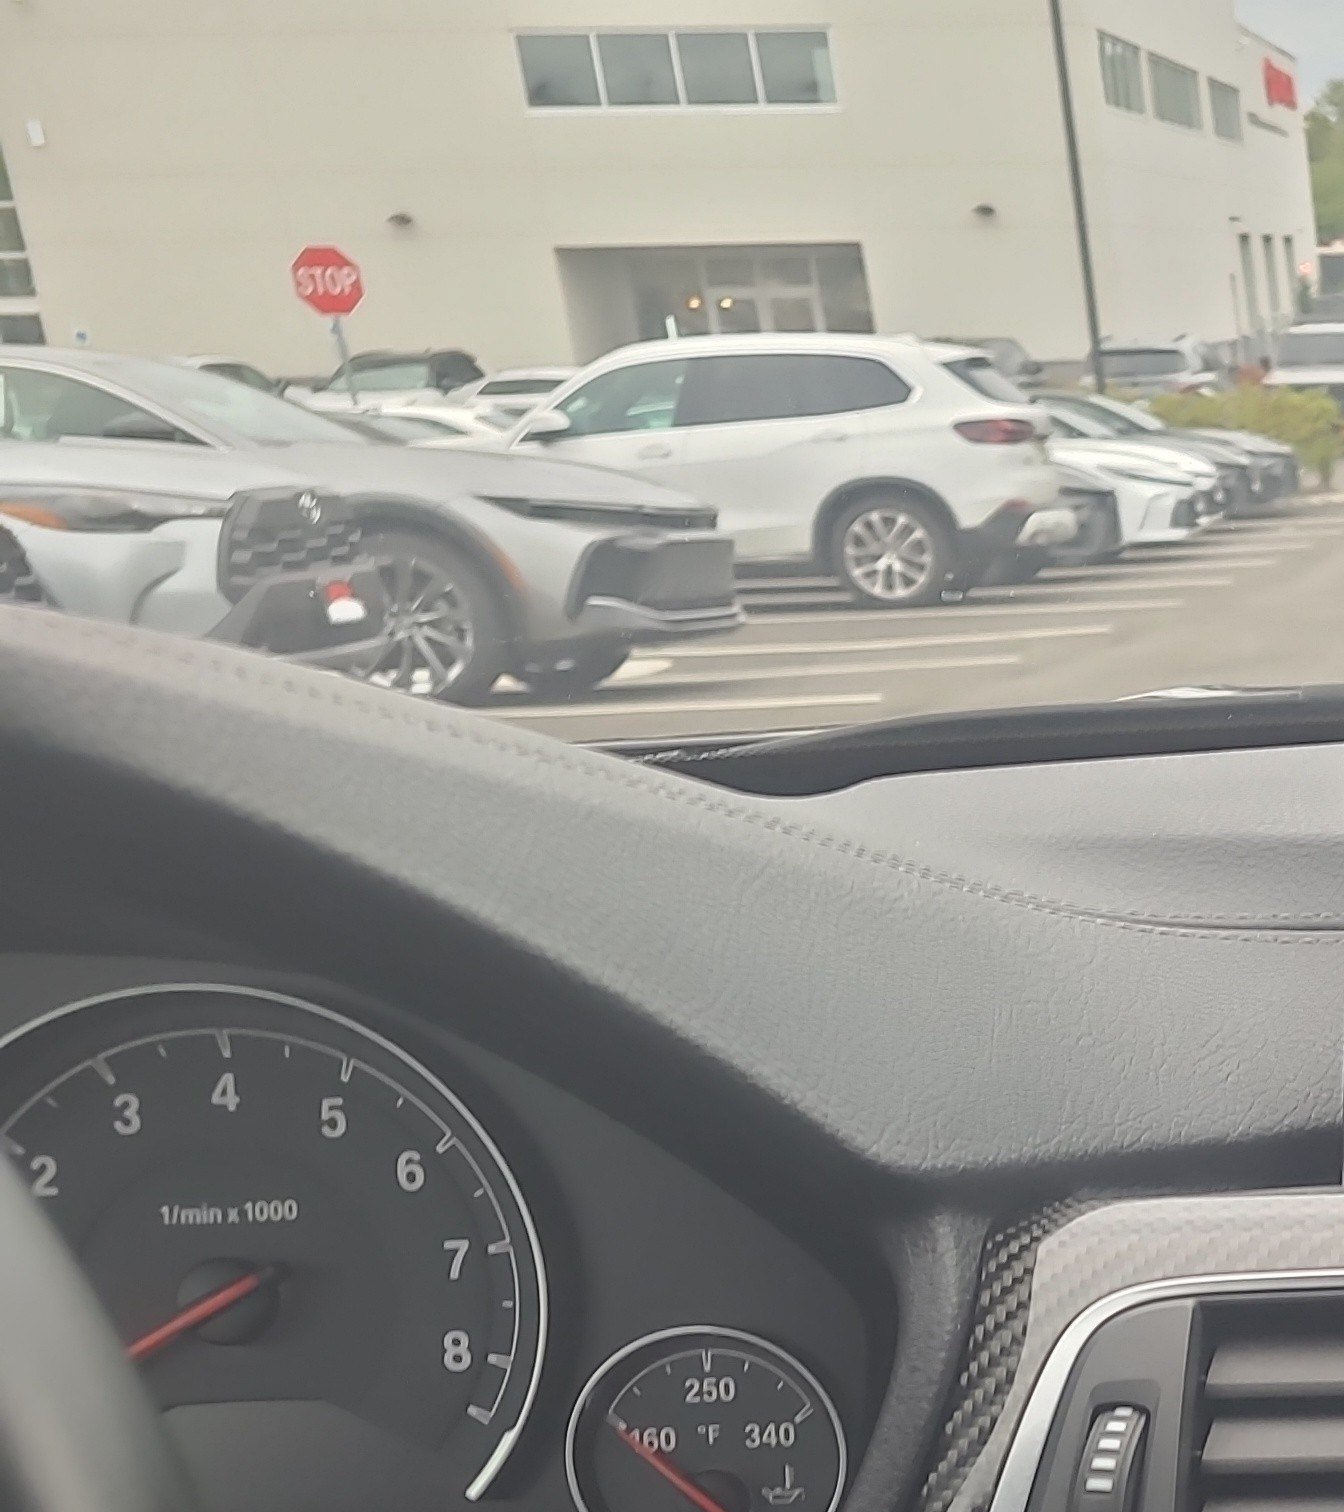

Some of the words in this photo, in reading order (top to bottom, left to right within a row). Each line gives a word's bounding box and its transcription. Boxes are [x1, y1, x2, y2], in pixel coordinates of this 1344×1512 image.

[296, 265, 358, 297] STOP
[112, 1092, 142, 1136] 3
[210, 1072, 241, 1113] 4
[320, 1096, 348, 1139] 5
[30, 1154, 59, 1198] 2
[396, 1149, 425, 1193] 6
[159, 1202, 222, 1226] 1/min
[243, 1198, 299, 1223] 1000
[443, 1238, 470, 1281] 7
[443, 1328, 473, 1373] 8
[684, 1376, 737, 1404] 250
[743, 1421, 796, 1450] 340
